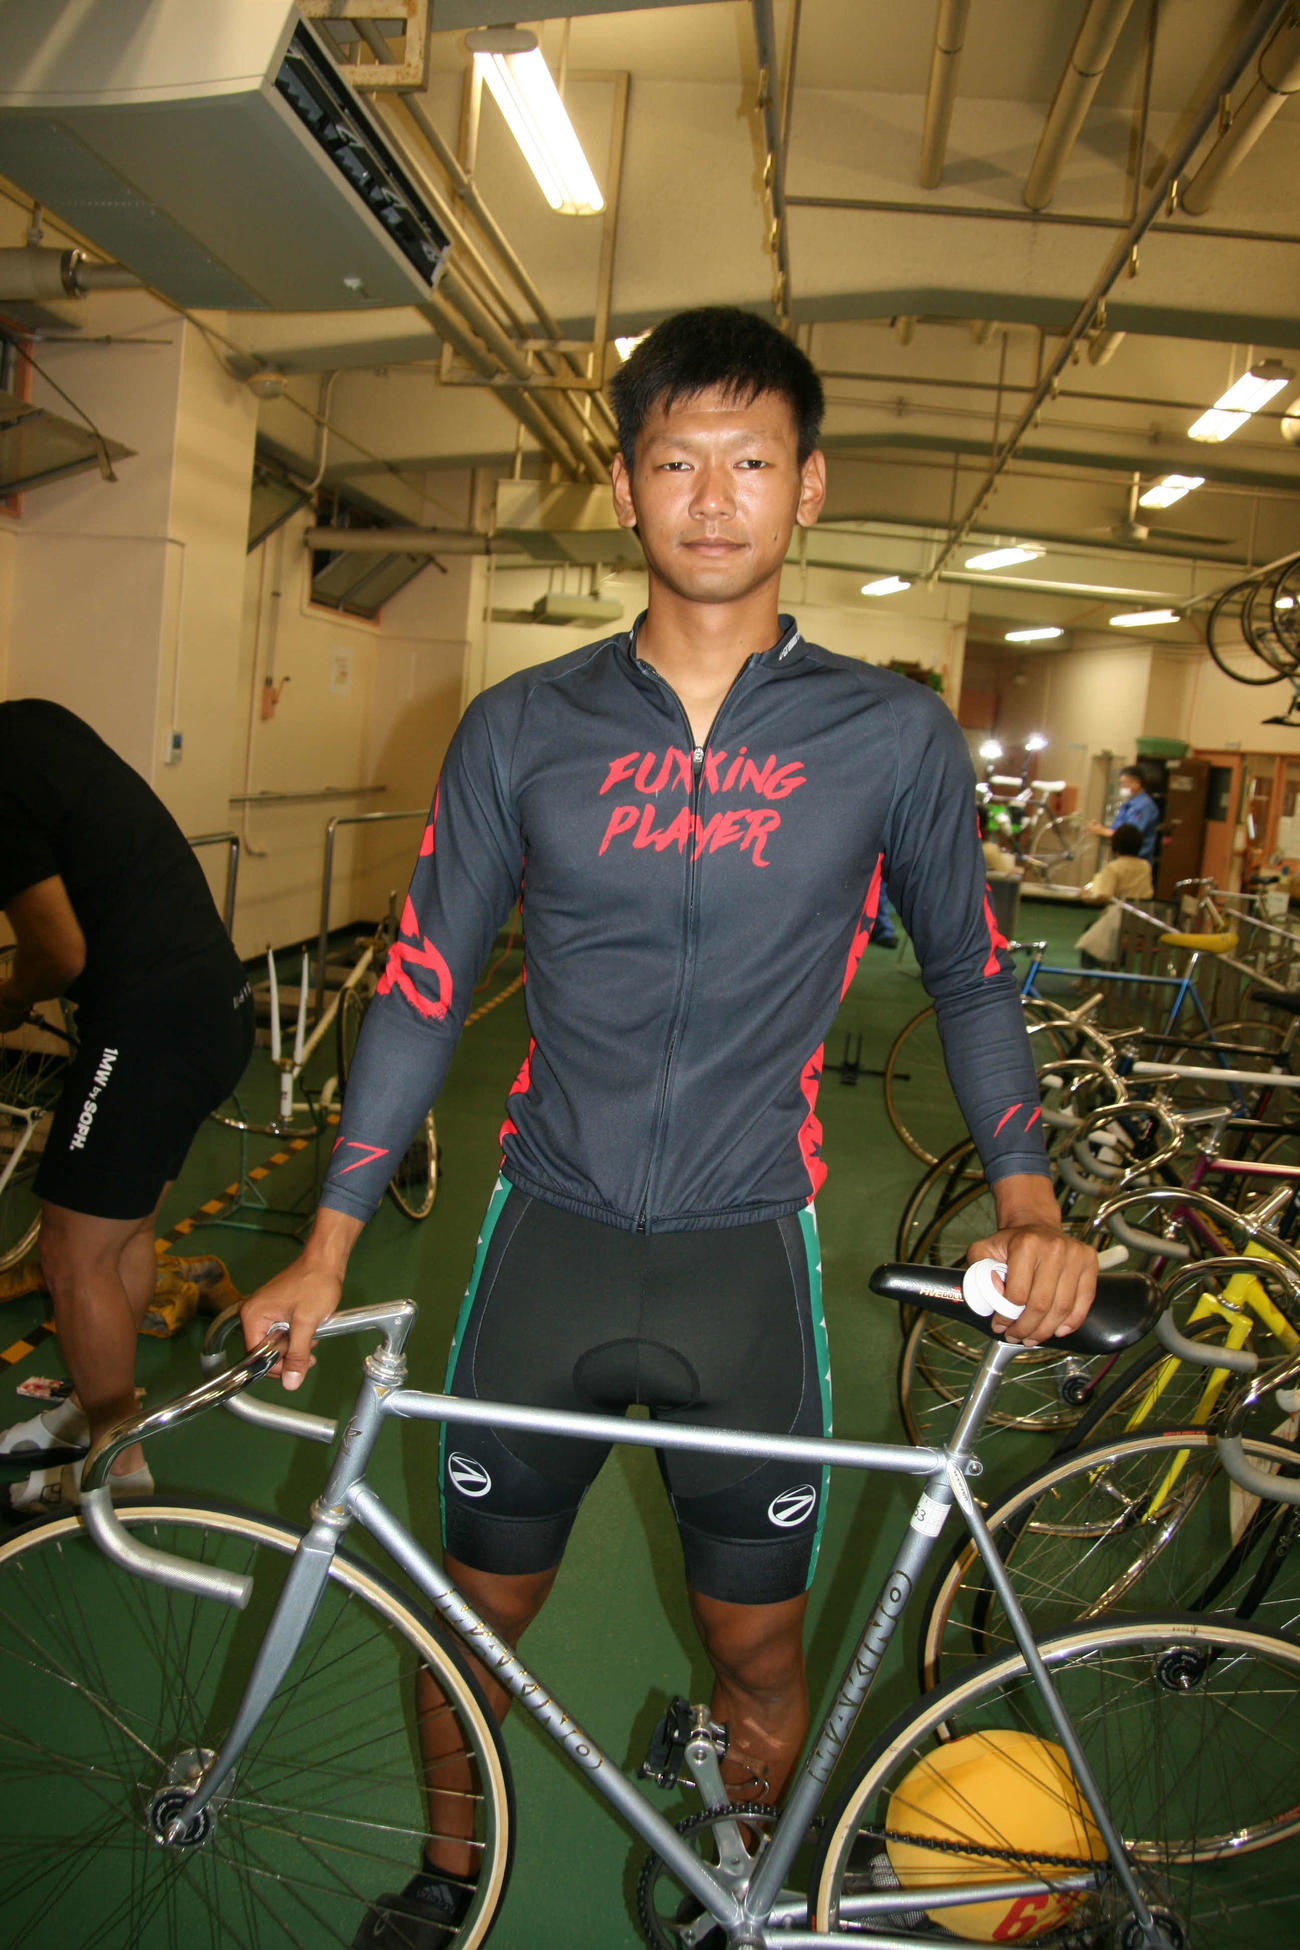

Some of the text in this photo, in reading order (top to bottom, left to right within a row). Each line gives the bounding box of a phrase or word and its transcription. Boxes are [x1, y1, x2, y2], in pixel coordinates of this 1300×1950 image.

[599, 803, 781, 867] PLAYER
[69, 1047, 119, 1151] 1MW by SOPH.
[431, 1588, 603, 1770] MAKINO
[806, 1569, 912, 1785] MAKINO
